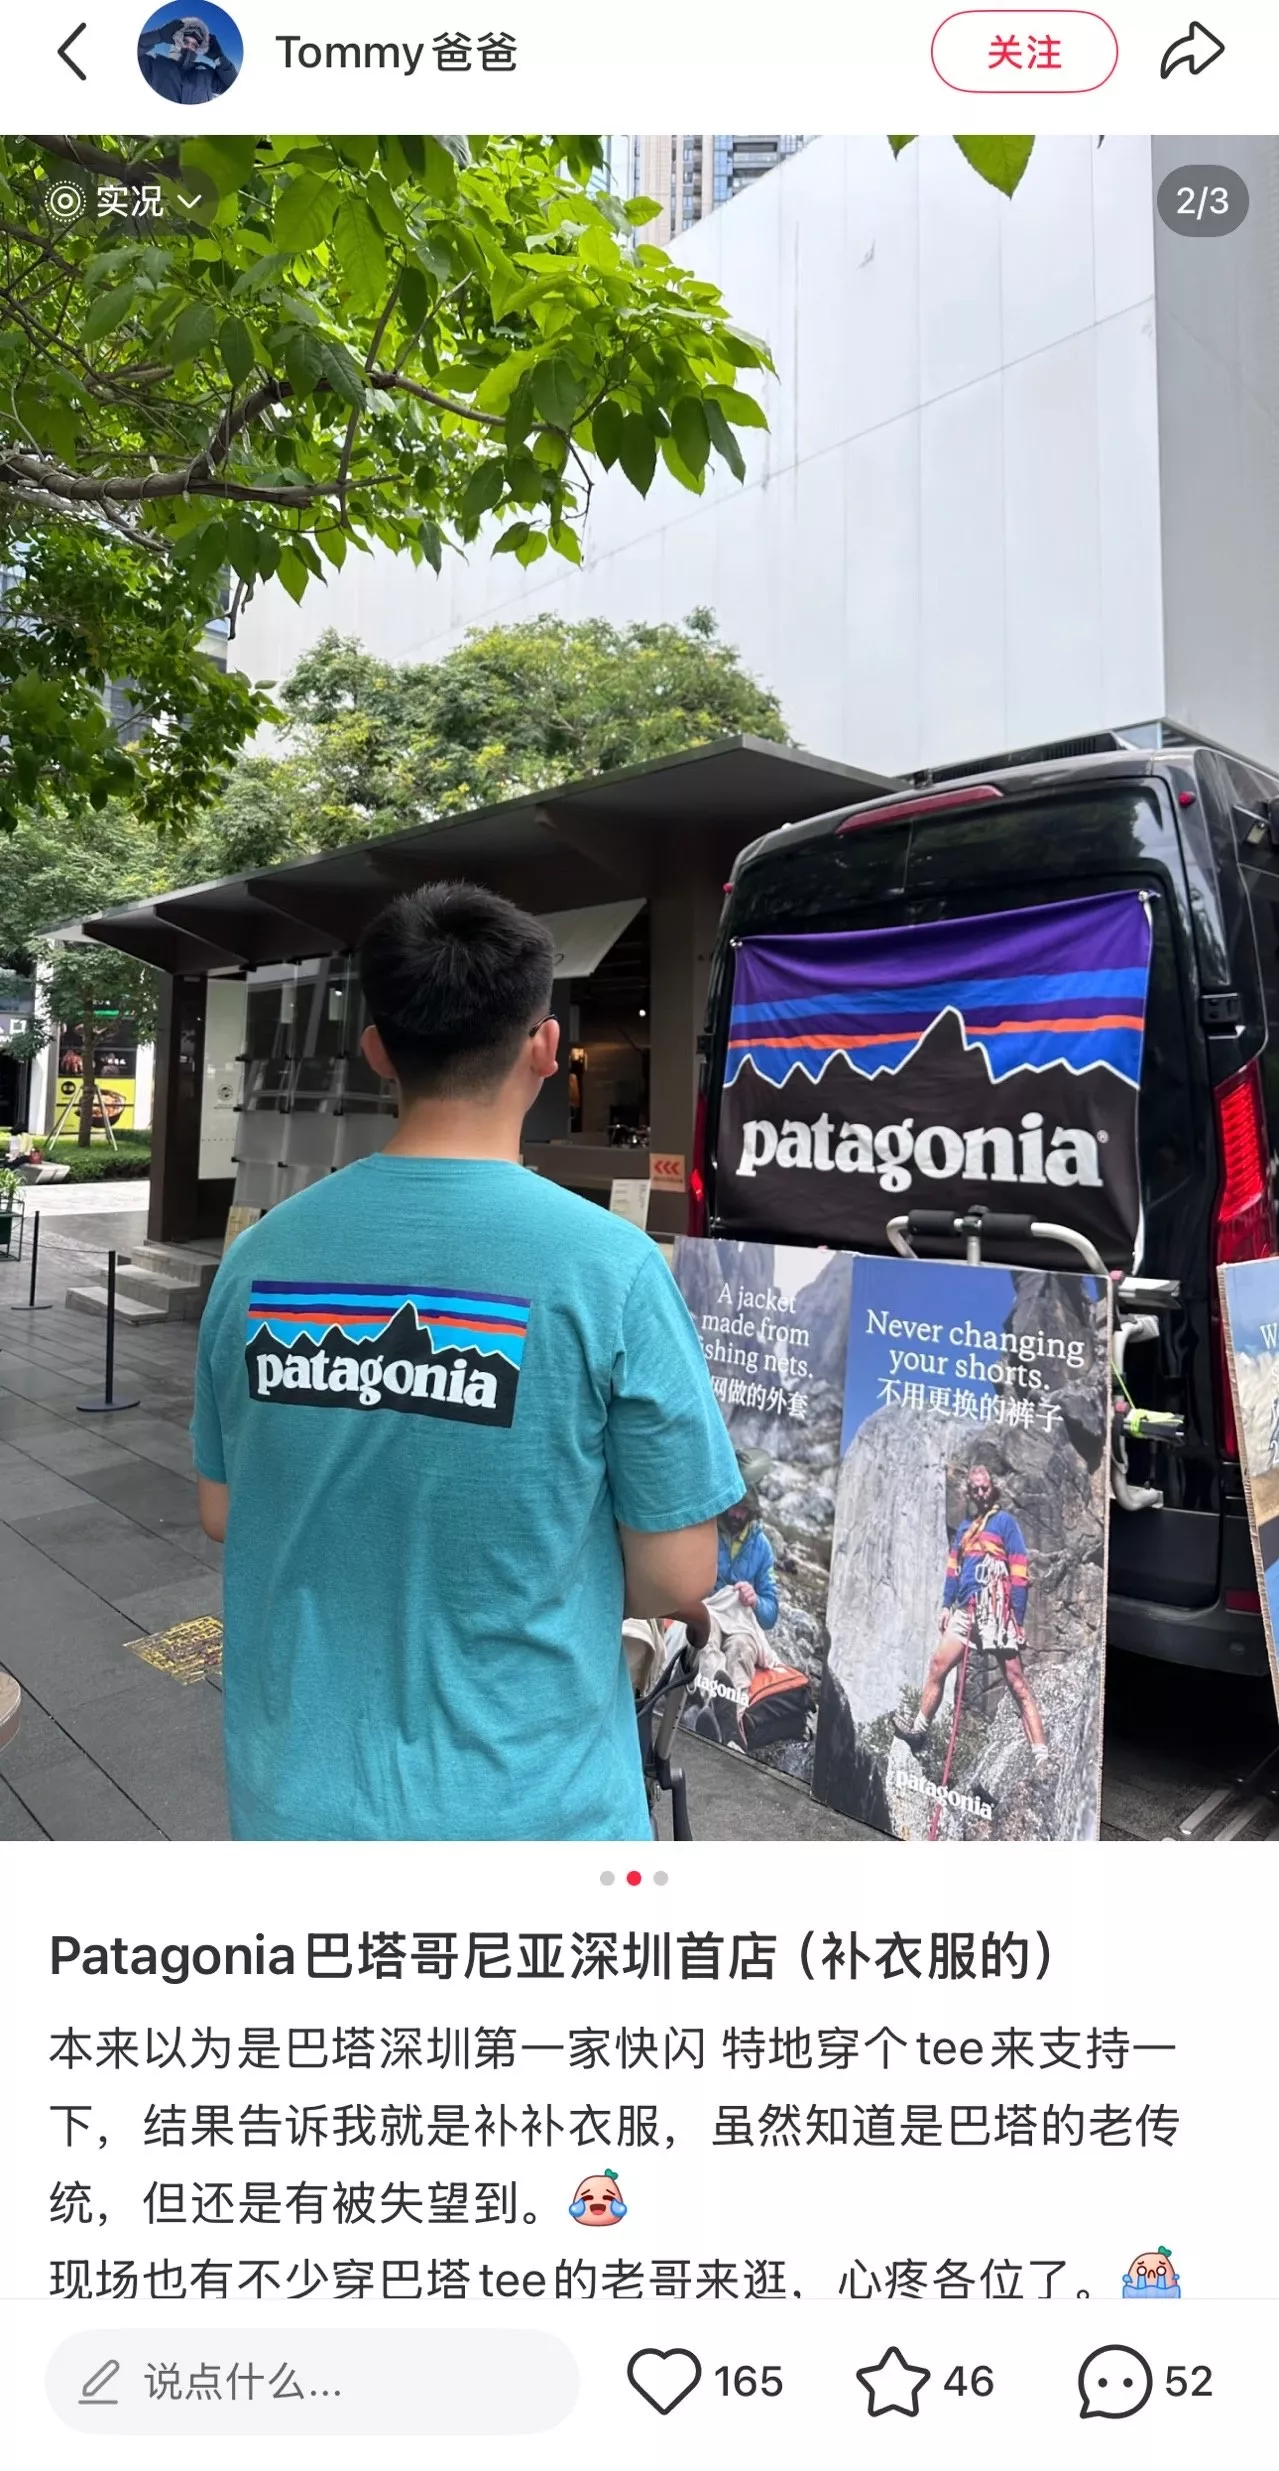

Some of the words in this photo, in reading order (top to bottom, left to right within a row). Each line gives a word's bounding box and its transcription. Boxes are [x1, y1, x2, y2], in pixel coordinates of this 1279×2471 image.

[717, 1282, 733, 1304] A
[737, 1285, 797, 1314] jacket
[701, 1313, 755, 1337] made
[760, 1317, 810, 1347] from
[866, 1309, 943, 1343] Never
[949, 1320, 1085, 1367] changing
[1260, 1322, 1279, 1349] W
[698, 1335, 759, 1374] shing
[763, 1354, 813, 1379] nets.
[889, 1349, 948, 1375] your
[954, 1353, 1050, 1391] shorts.
[256, 1349, 498, 1409] patagonia
[877, 1377, 1064, 1433] 不用更换的裤子
[695, 1672, 750, 1708] tagonia
[895, 1770, 995, 1820] patagonia
